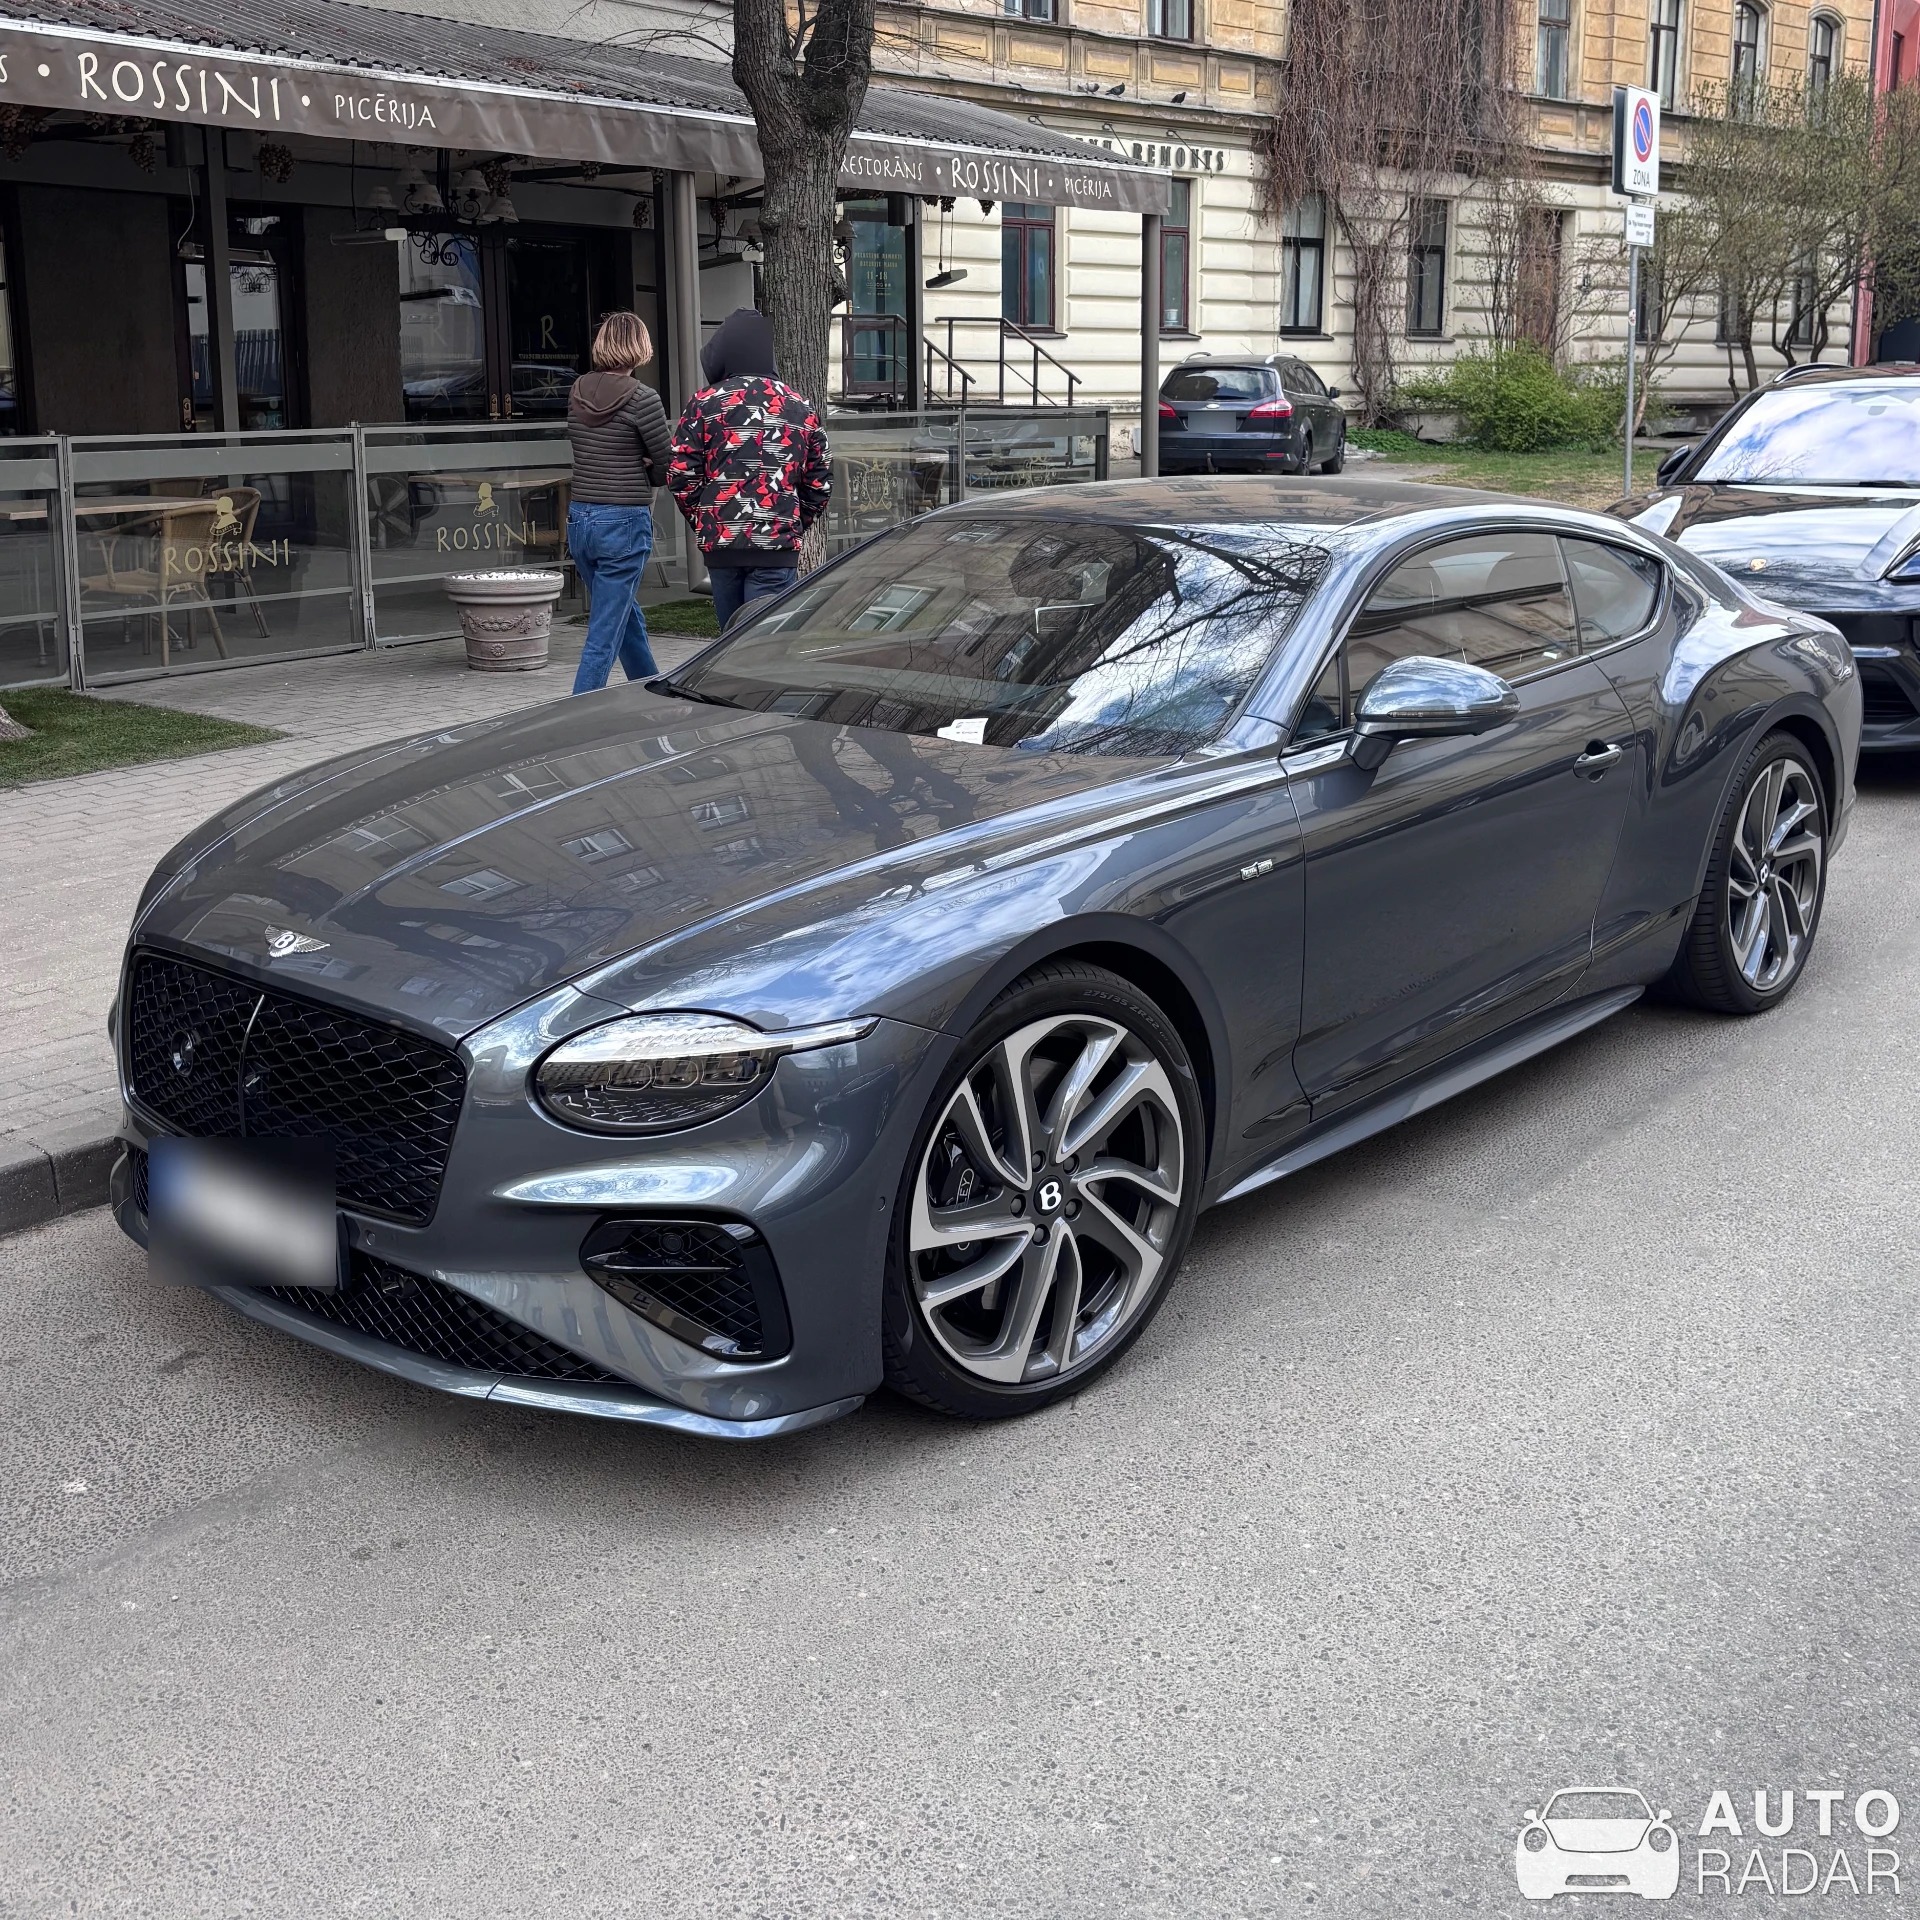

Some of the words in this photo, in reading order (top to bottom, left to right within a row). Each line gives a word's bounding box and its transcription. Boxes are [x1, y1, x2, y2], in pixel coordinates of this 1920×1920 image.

[78, 52, 280, 121] ROSSINI
[335, 94, 437, 129] PICĒRIJA
[1132, 142, 1224, 171] REMONTS
[840, 154, 922, 181] RESTORĀNS
[952, 157, 1039, 197] ROSSINI
[1064, 175, 1112, 200] PICĒRIJA
[1633, 169, 1650, 188] ZONA
[540, 314, 559, 349] R
[436, 520, 536, 553] ROSSINI
[163, 538, 289, 576] ROSSINI
[1039, 1181, 1062, 1210] B
